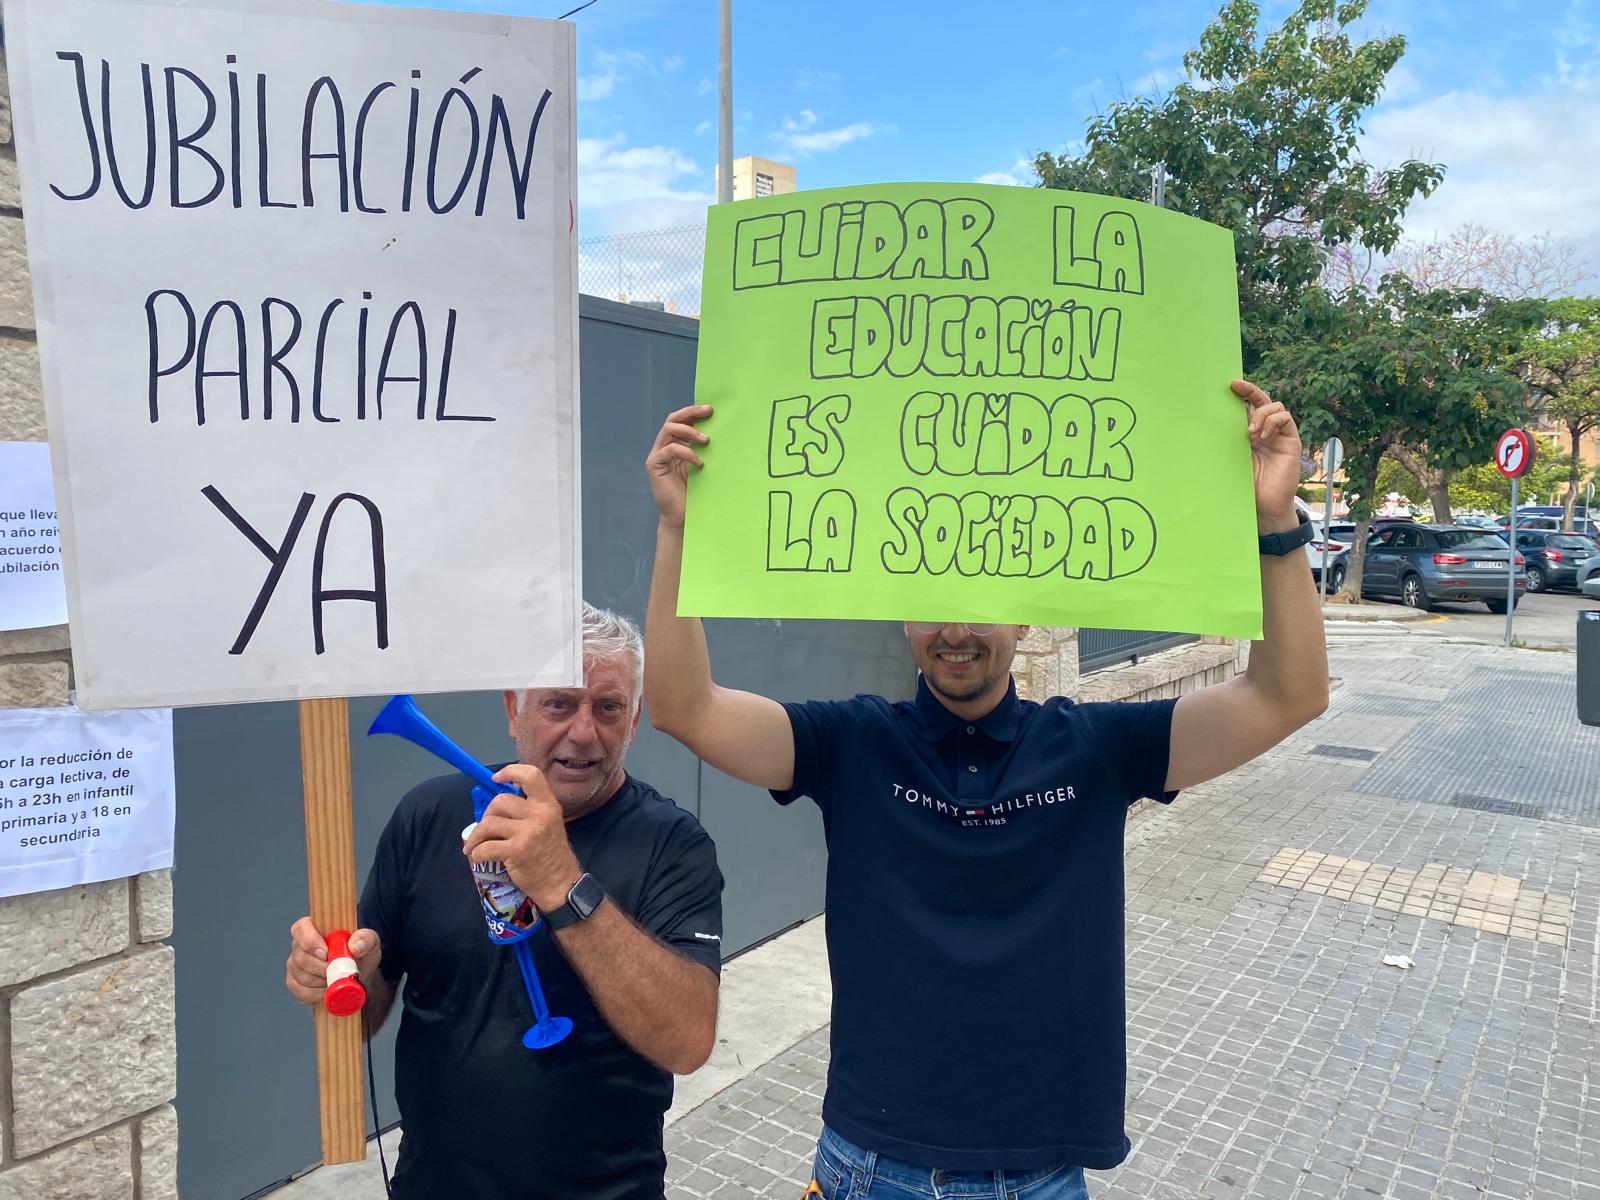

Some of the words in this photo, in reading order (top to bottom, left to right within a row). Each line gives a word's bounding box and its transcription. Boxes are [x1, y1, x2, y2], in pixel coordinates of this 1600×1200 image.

[1053, 205, 1144, 295] LA
[768, 395, 851, 478] ES
[0, 511, 26, 523] que
[10, 527, 36, 538] año
[767, 489, 857, 572] LA
[0, 544, 55, 556] acuerdo
[0, 561, 60, 573] ubilación
[201, 485, 388, 655] YA
[0, 759, 16, 769] or
[21, 755, 35, 768] la
[40, 749, 112, 766] reducción
[116, 747, 133, 760] de
[9, 775, 55, 789] carga
[60, 769, 107, 784] lectiva,
[112, 767, 130, 779] de
[18, 798, 27, 808] a
[32, 792, 62, 806] 23h
[66, 792, 80, 803] en
[83, 784, 134, 800] infantil
[893, 783, 959, 816] TOMMY
[991, 786, 1076, 815] HILFIGER
[1, 812, 67, 833] primaria
[92, 805, 109, 818] 18
[113, 806, 131, 816] en
[984, 817, 1007, 826] 1985
[20, 826, 101, 848] secundaria
